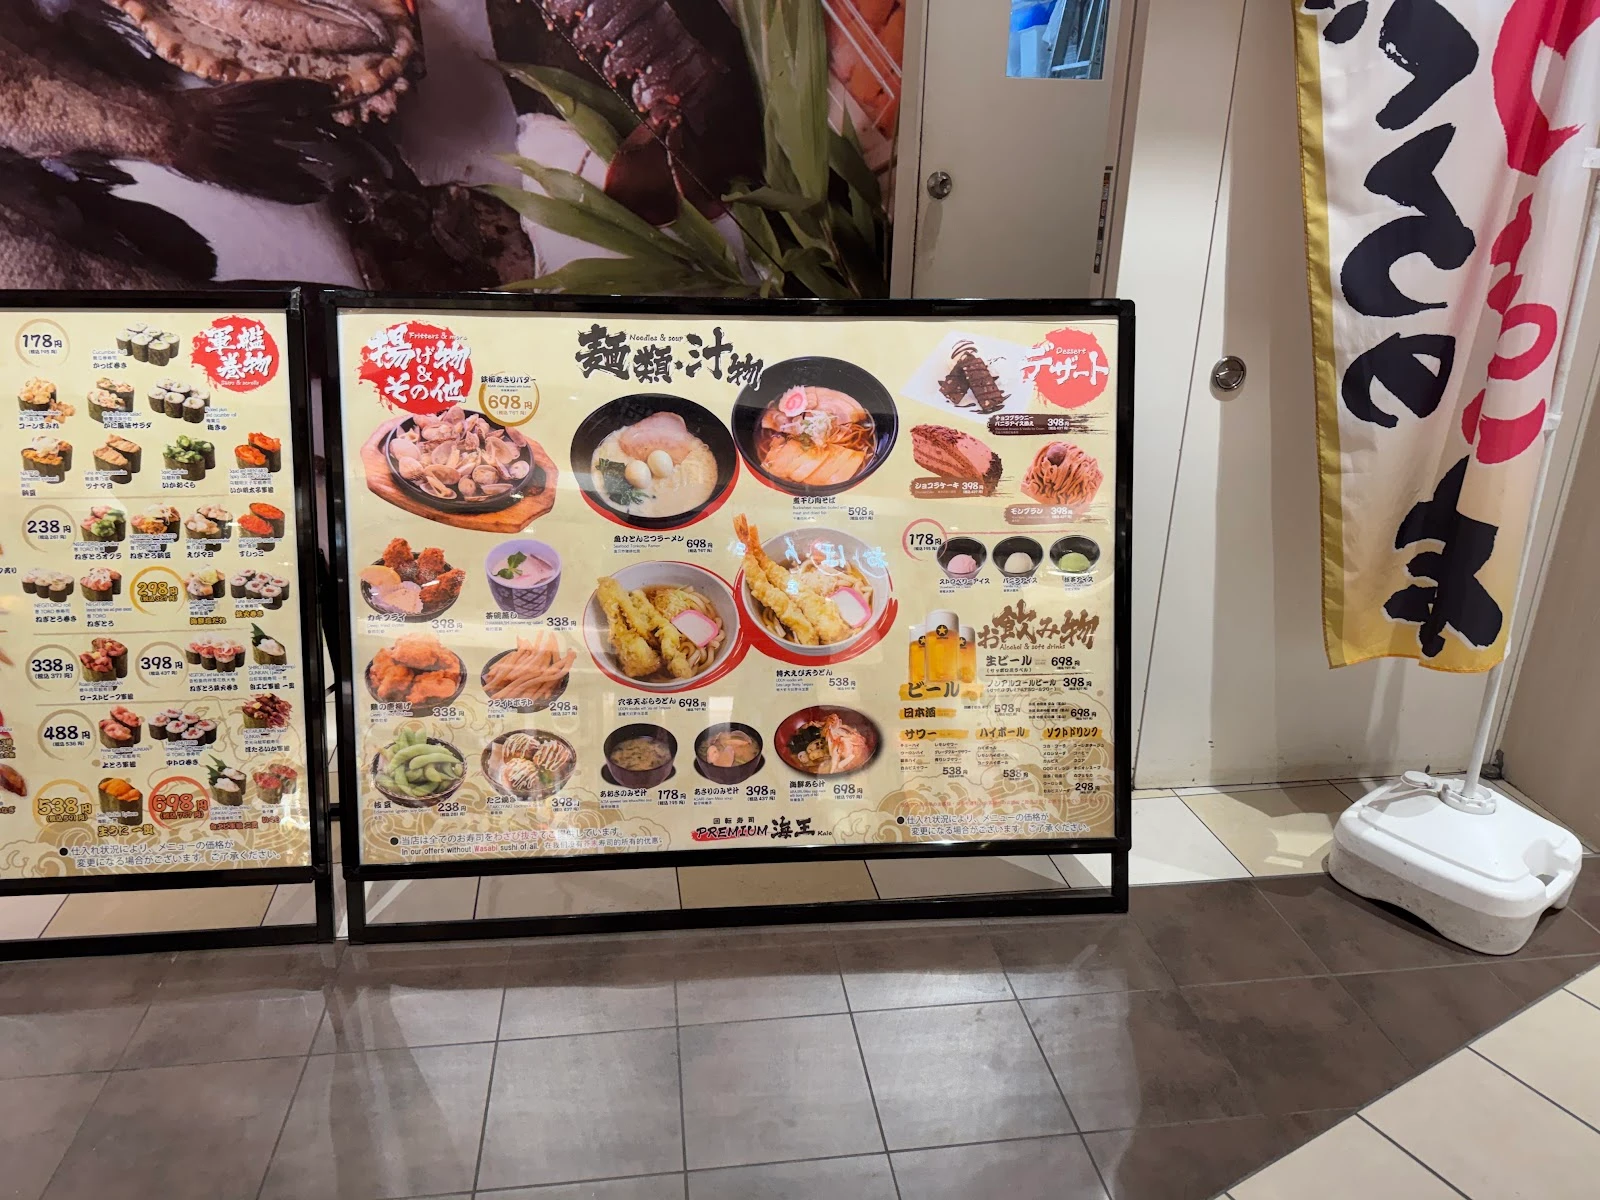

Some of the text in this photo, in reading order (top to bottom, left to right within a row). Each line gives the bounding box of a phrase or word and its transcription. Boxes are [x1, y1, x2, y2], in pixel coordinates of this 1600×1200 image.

[203, 324, 266, 356] 軍艦
[409, 332, 440, 340] Fritters
[440, 332, 448, 340] &
[629, 334, 684, 343] Noodles & soup
[368, 324, 471, 375] 揚げ物
[1056, 347, 1087, 355] Dessert
[216, 351, 273, 380] 巻物
[1020, 342, 1110, 386] デザート
[416, 365, 433, 383] &
[384, 372, 466, 404] その他
[977, 598, 1100, 650] お飲み物
[985, 655, 1032, 667] 生ビール
[908, 681, 960, 698] ビール
[903, 706, 936, 718] 日本酒
[905, 728, 937, 740] サワー
[979, 726, 1026, 738] ハイボール
[1047, 726, 1099, 738] ソフトドリンク
[696, 824, 769, 839] PREMIUM
[770, 815, 815, 839] 海王
[423, 846, 445, 855] offers
[446, 845, 472, 854] without
[474, 844, 498, 852] Wasabi
[500, 843, 518, 851] sushi
